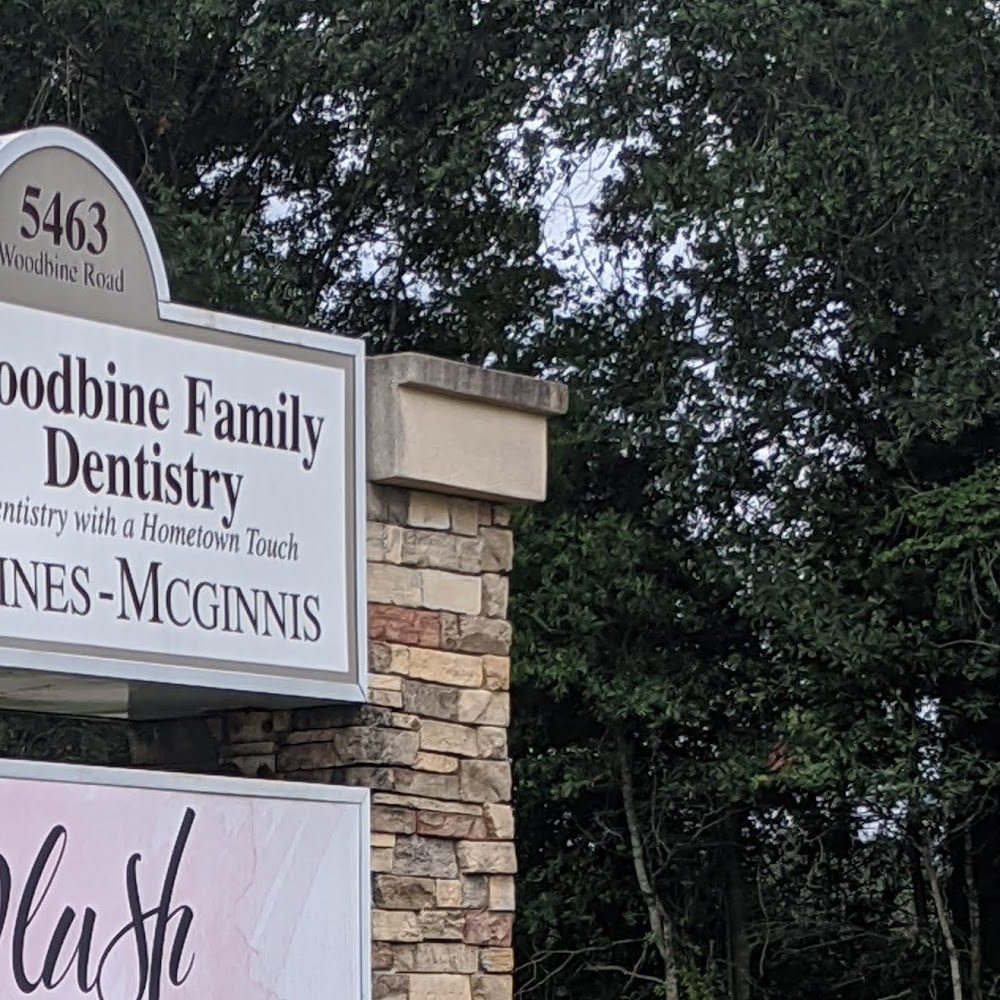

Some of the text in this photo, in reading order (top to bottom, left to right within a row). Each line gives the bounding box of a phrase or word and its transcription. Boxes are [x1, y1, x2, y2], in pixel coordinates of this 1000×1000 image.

[19, 185, 109, 255] 5463
[83, 263, 125, 293] Road
[183, 374, 325, 470] Family
[43, 425, 244, 529] Dentistry
[73, 503, 117, 533] with
[121, 520, 135, 540] a
[140, 511, 241, 554] Hometown
[245, 525, 300, 562] Touch
